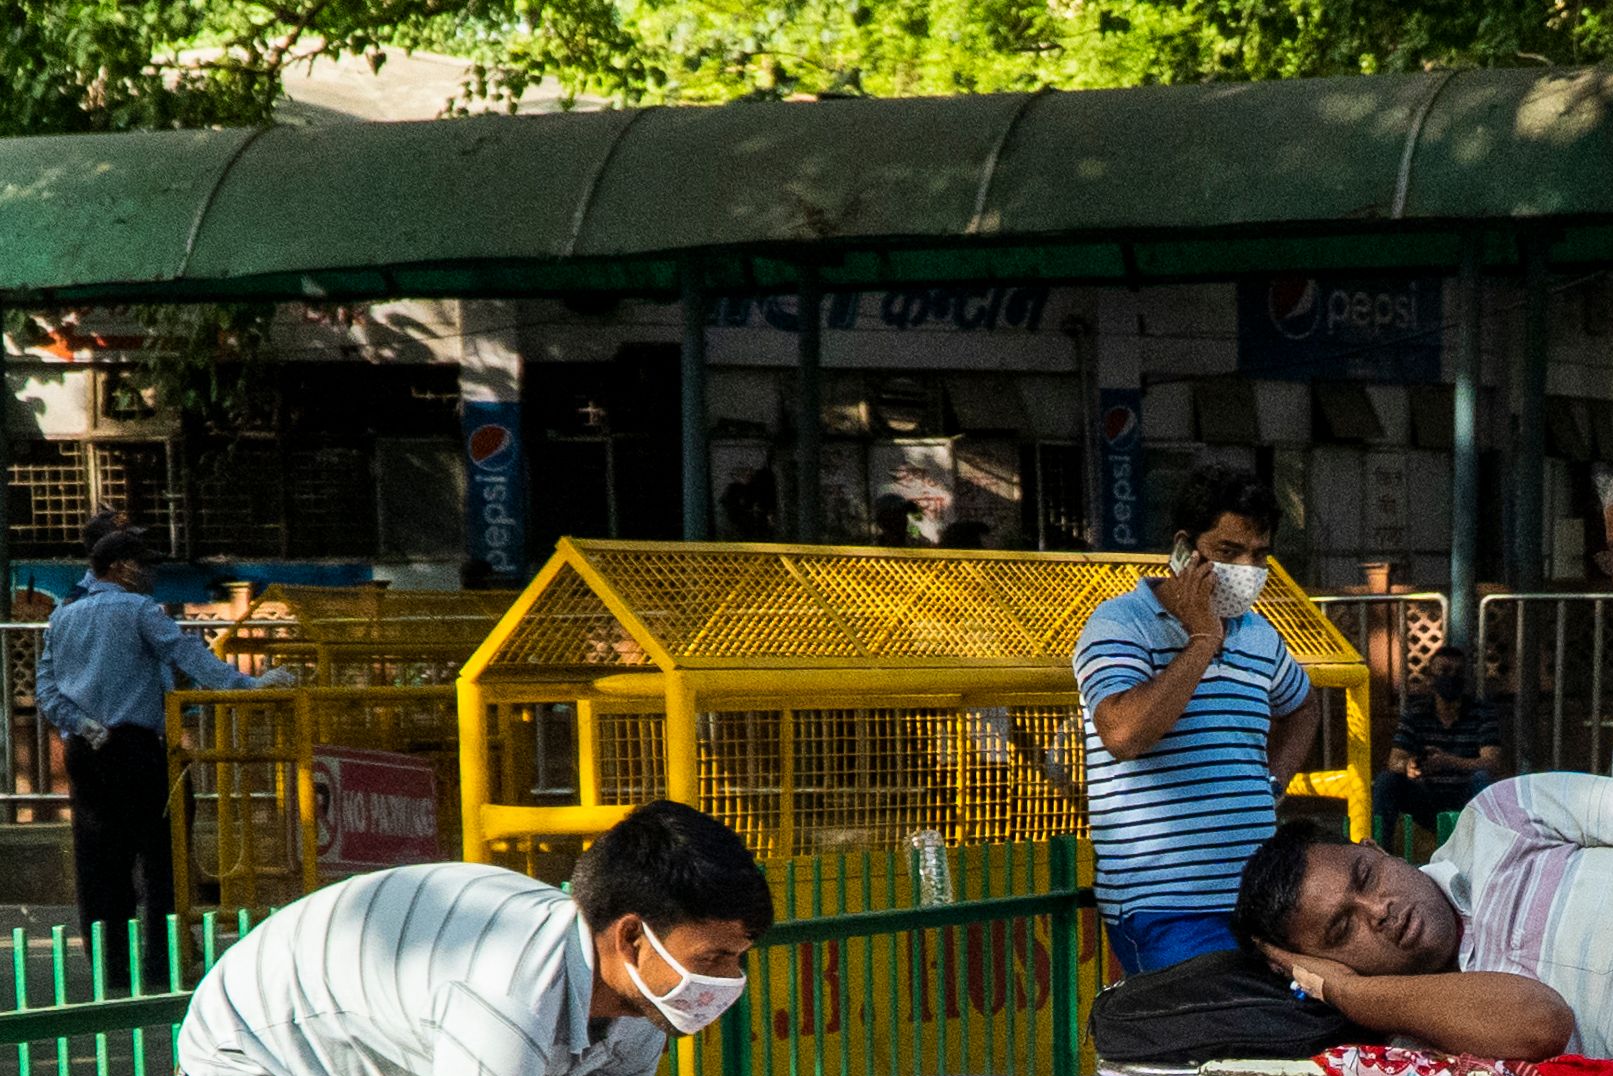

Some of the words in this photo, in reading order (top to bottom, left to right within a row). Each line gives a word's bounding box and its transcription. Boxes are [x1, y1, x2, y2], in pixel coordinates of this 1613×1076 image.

[1327, 281, 1419, 335] pepsi
[474, 475, 517, 572] pepsi
[1108, 454, 1138, 545] pepsi
[342, 790, 366, 833] NO
